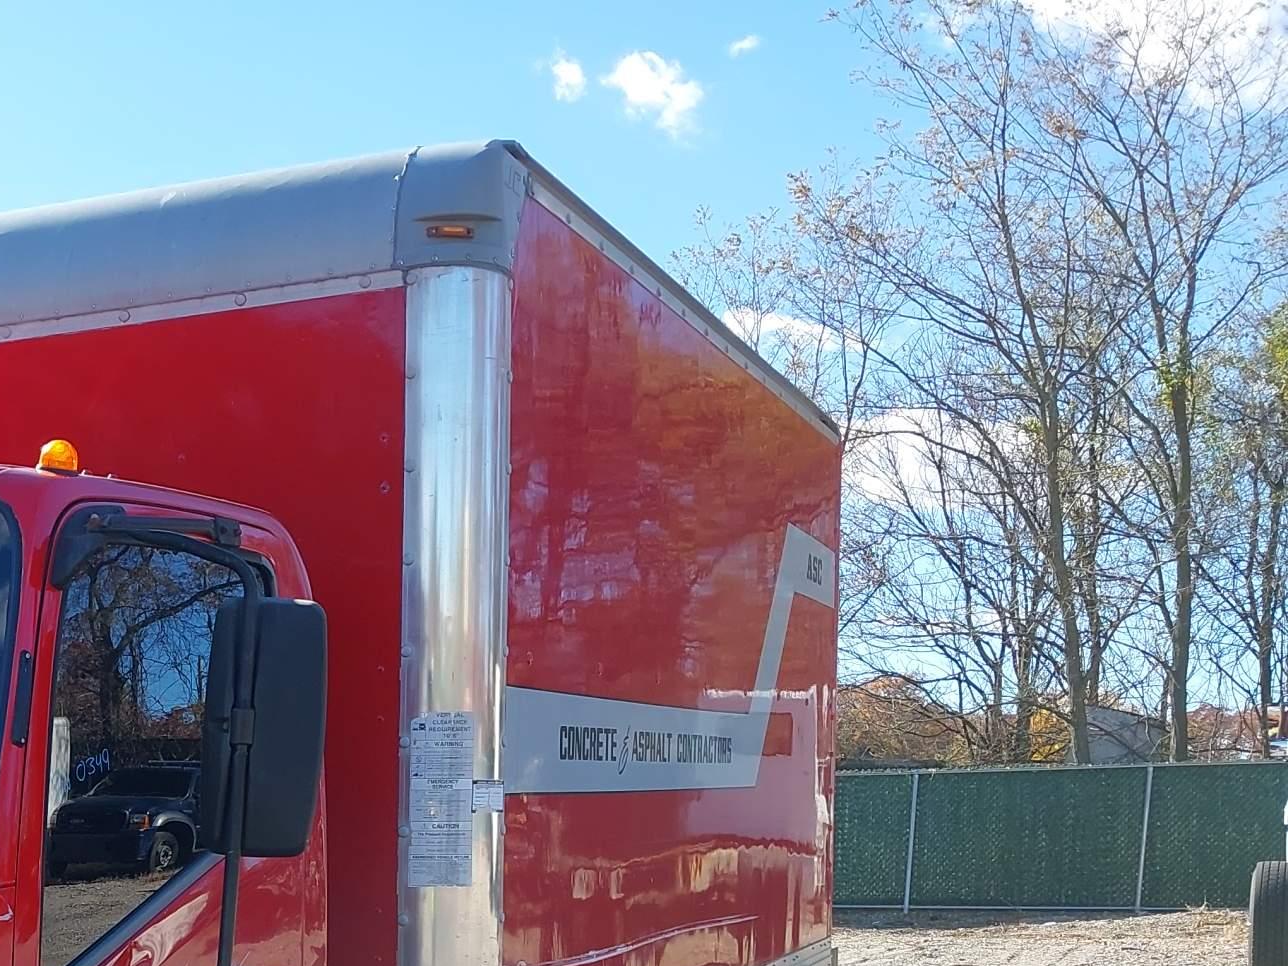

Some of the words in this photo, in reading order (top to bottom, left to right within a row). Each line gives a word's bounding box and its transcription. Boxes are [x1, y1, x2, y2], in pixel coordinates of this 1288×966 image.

[806, 552, 823, 586] ASC
[559, 725, 618, 762] CONCRETE
[631, 730, 673, 763] ASPHALT
[676, 733, 733, 764] CONTRACTORS
